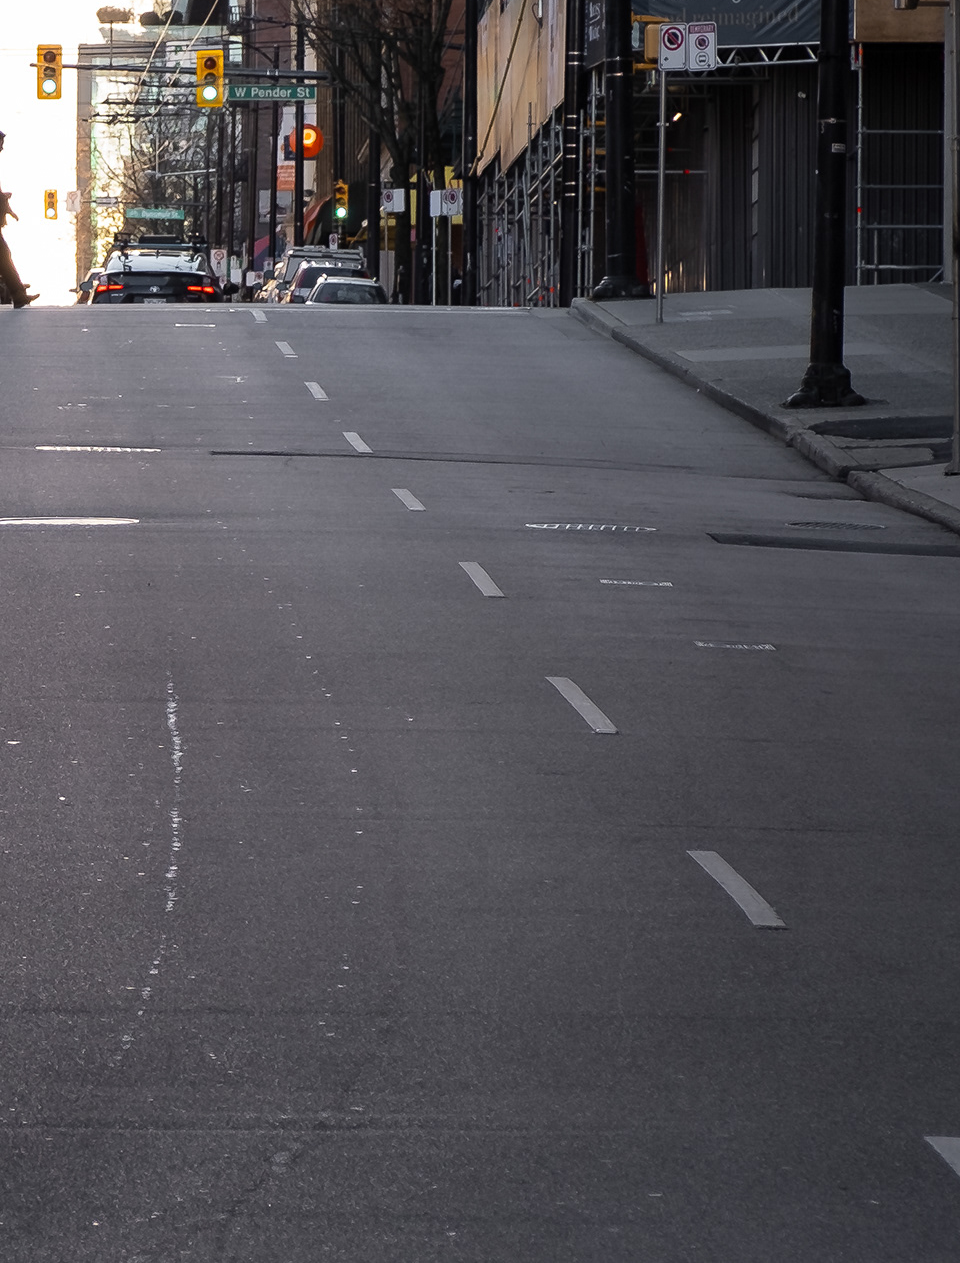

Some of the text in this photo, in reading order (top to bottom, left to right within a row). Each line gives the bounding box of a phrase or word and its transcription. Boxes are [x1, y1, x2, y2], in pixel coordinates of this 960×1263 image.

[234, 86, 311, 98] W Pender St
